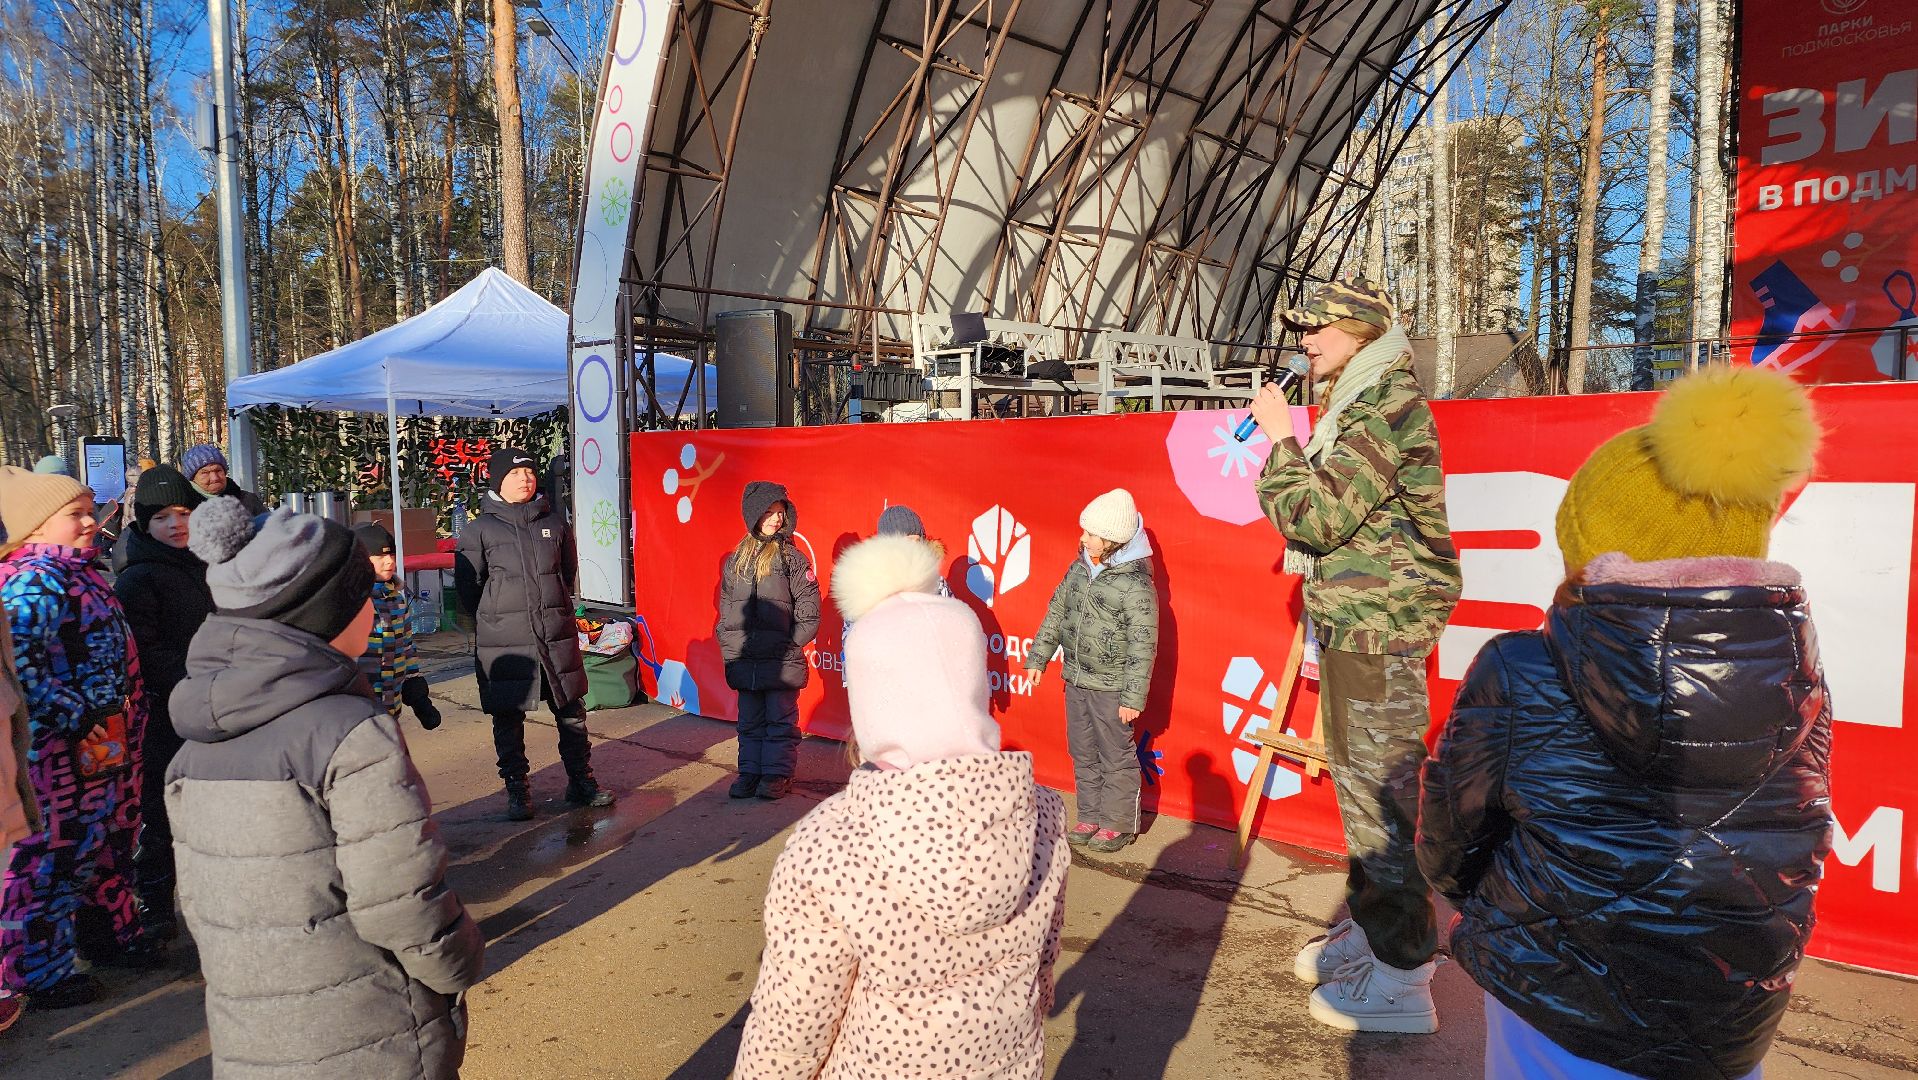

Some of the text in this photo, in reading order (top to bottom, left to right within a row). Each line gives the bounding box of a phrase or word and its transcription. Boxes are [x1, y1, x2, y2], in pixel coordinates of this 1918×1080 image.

[1782, 21, 1912, 58] ПОДМОСКОВЬЯ
[1818, 15, 1873, 37] ПАРКИ
[1759, 184, 1783, 211] В
